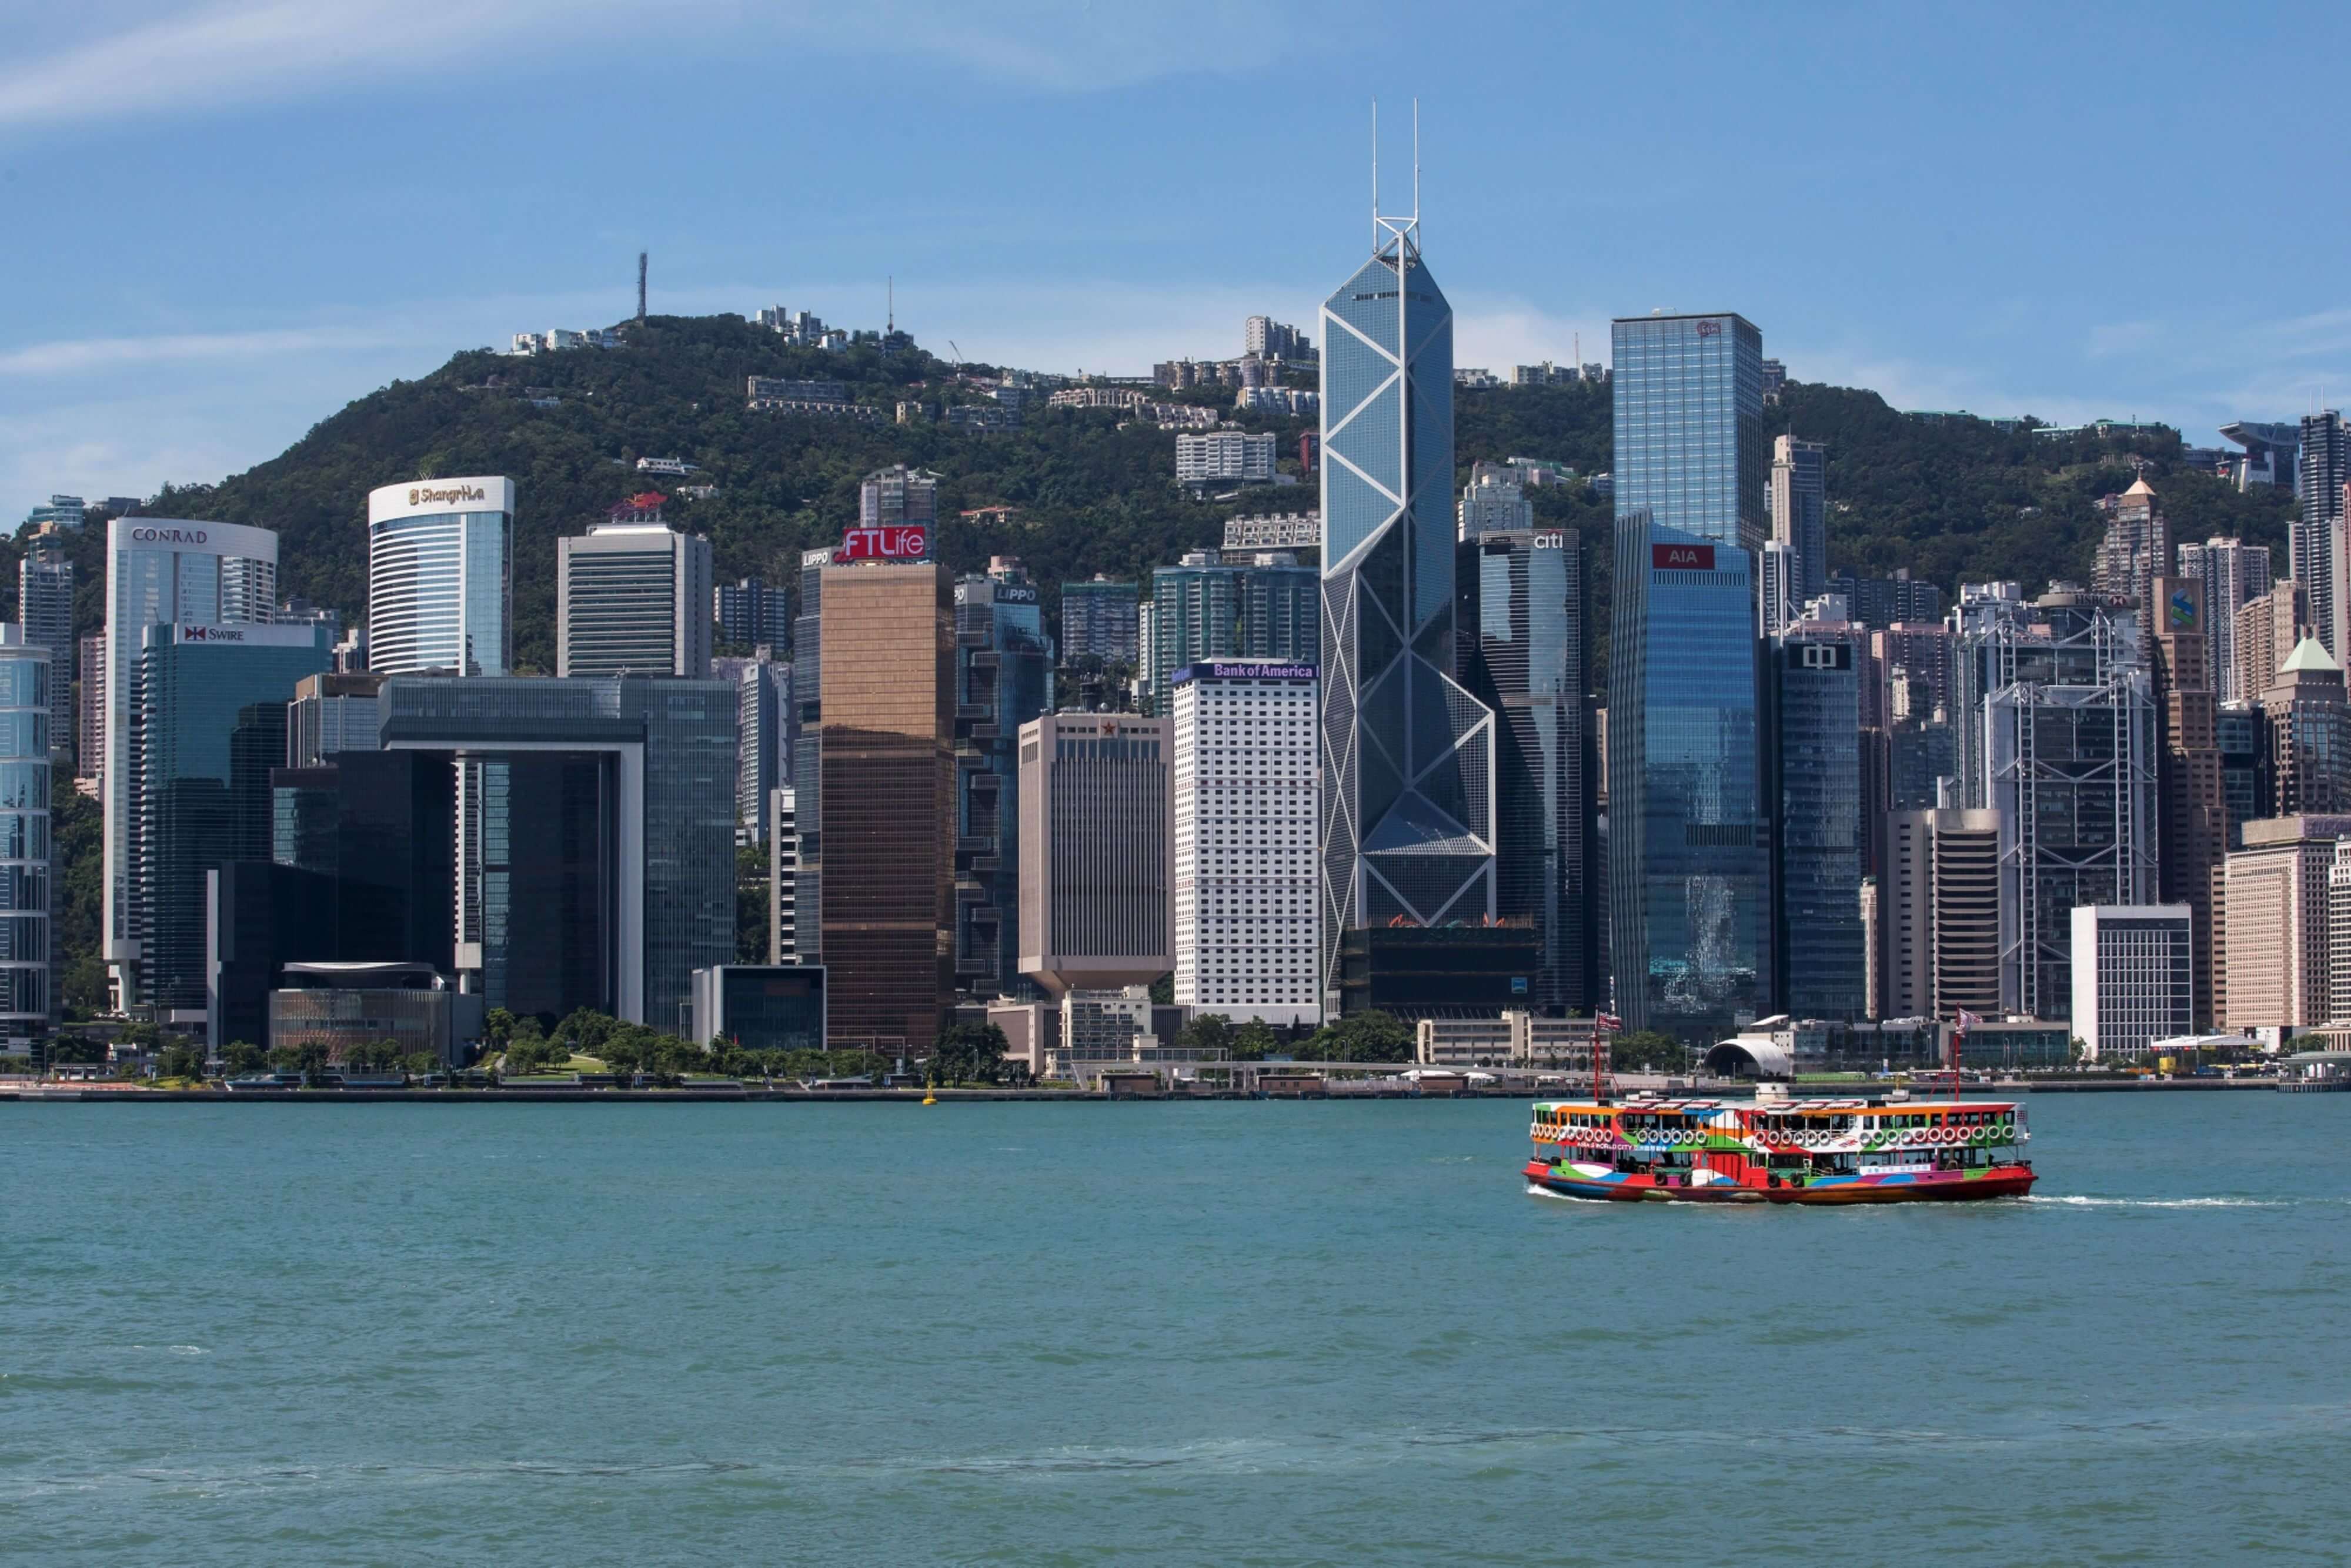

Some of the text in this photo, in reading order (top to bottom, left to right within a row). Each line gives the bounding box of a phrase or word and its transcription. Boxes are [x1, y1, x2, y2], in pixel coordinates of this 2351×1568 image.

[133, 528, 207, 544] CONRAD
[846, 530, 924, 556] FTLife
[1534, 532, 1562, 549] citi
[803, 551, 828, 566] LIPPO
[1669, 550, 1698, 563] AIA
[997, 589, 1036, 601] LIPPO
[2075, 594, 2108, 604] HSBC
[1214, 664, 1313, 677] Bank of America
